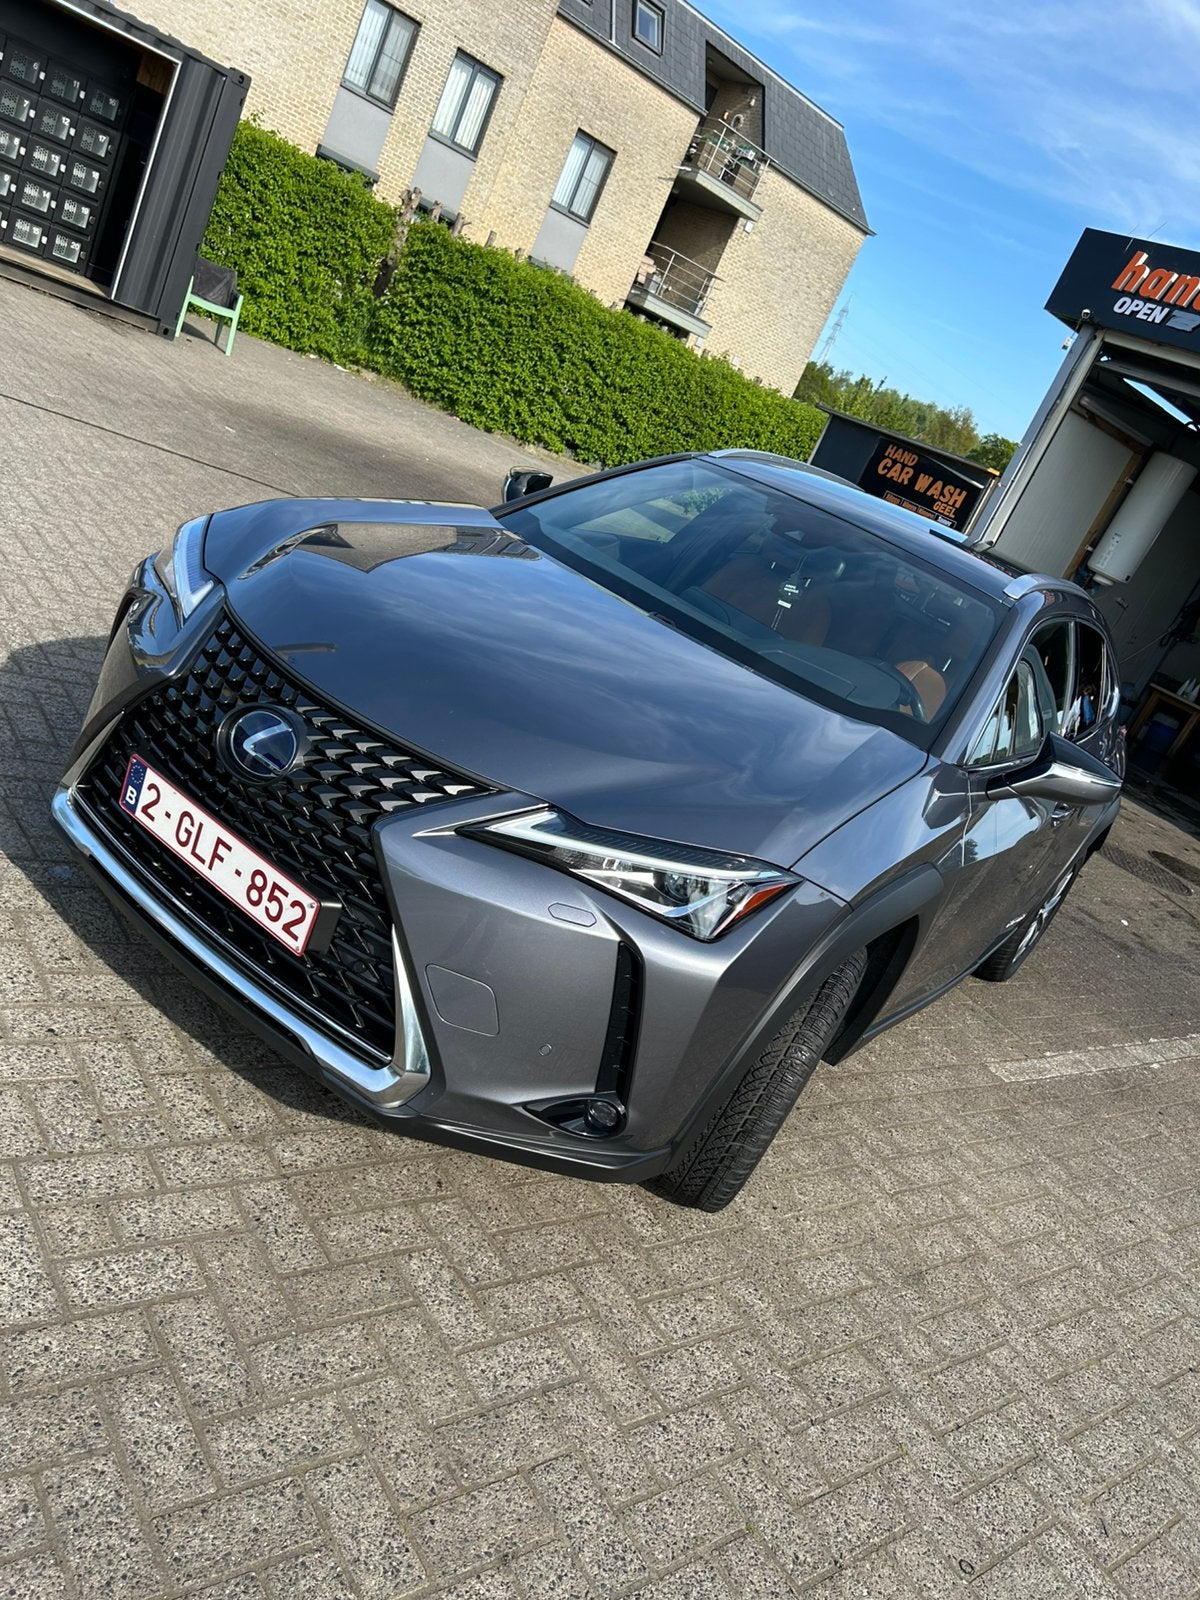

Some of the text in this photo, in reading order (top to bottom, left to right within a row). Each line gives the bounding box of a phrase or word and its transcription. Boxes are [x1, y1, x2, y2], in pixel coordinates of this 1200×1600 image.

[32, 62, 39, 70] 6
[73, 80, 80, 89] 11
[23, 99, 30, 107] 7
[62, 116, 71, 126] 12
[70, 241, 80, 251] 20
[1111, 251, 1200, 312] han
[1113, 297, 1170, 324] OPEN
[884, 444, 919, 466] HAND
[877, 458, 967, 509] CAR WASH
[932, 501, 957, 519] GEEL
[126, 786, 137, 805] B
